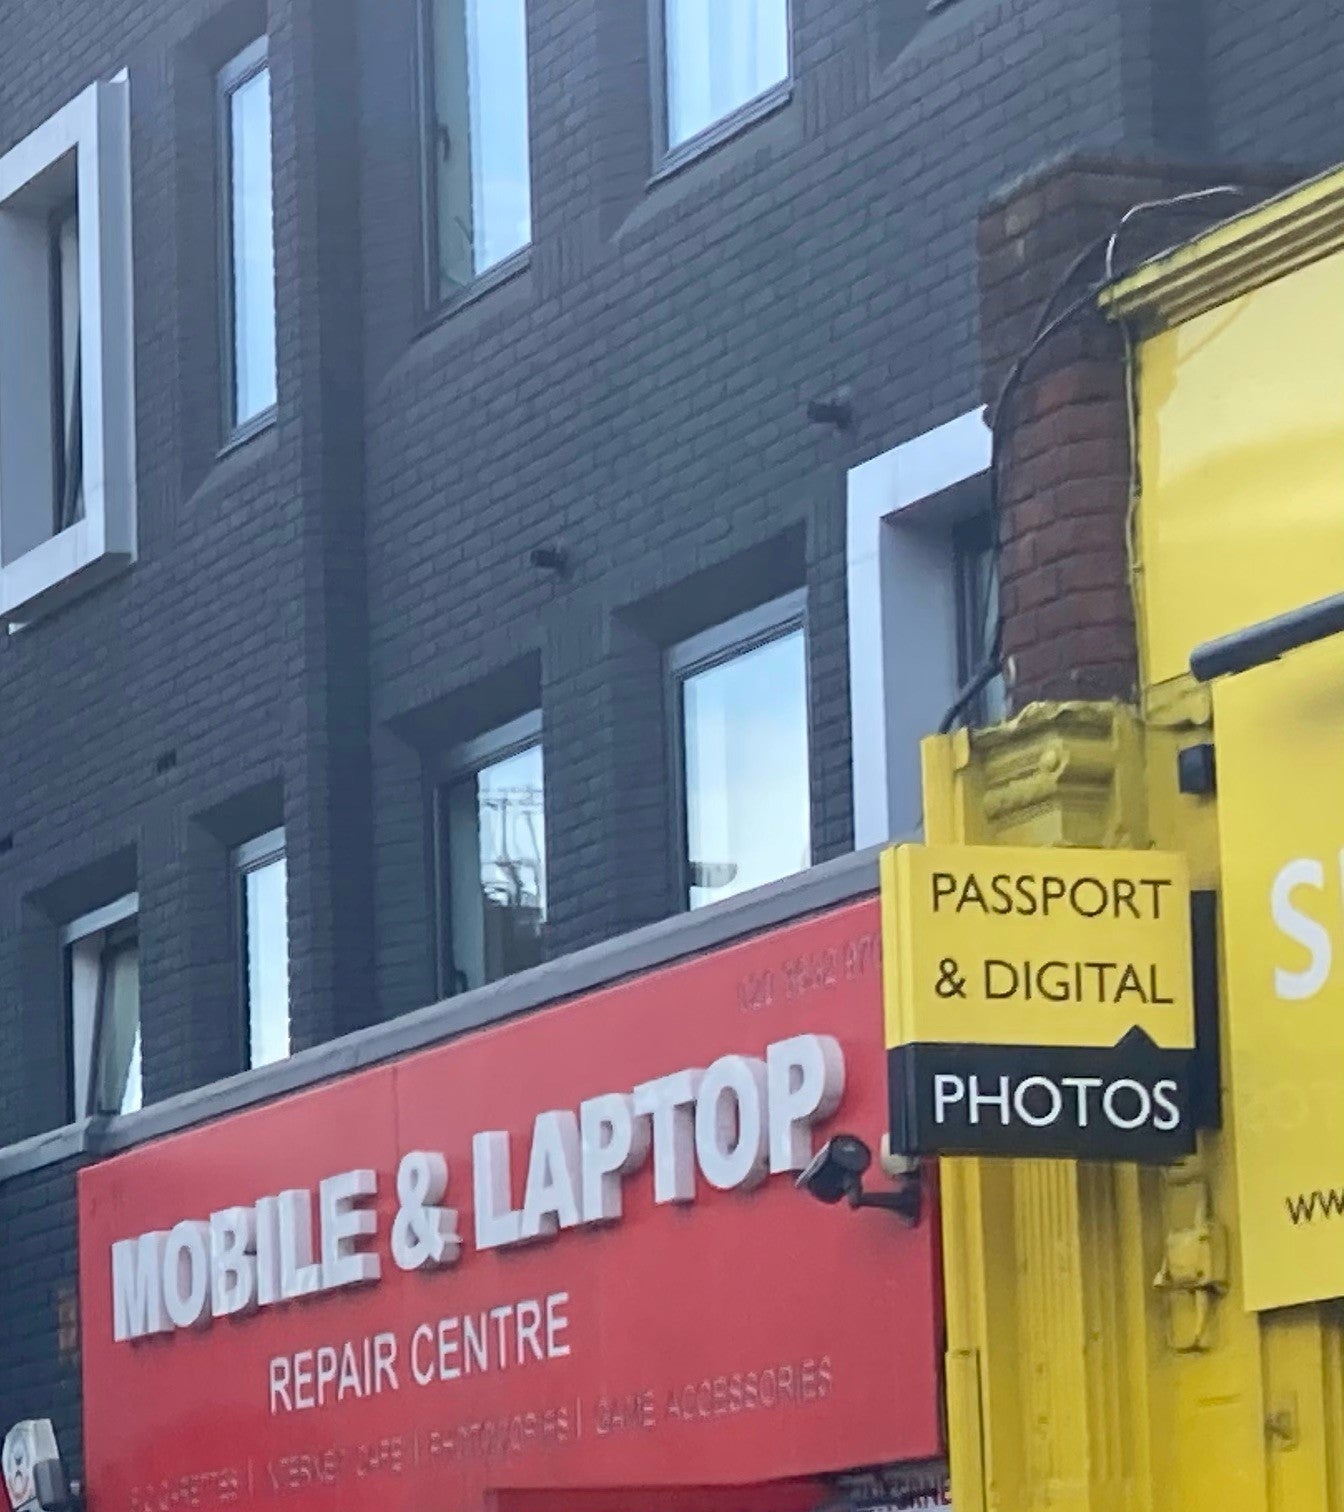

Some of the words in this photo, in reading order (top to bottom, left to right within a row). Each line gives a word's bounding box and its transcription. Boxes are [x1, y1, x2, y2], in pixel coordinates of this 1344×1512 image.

[932, 872, 1172, 919] PASSPORT
[934, 957, 967, 999] &
[984, 959, 1174, 1004] DIGITAL
[933, 1073, 1181, 1131] PHOTOS
[111, 1168, 381, 1343] MOBILE
[391, 1151, 462, 1273] &
[472, 1033, 846, 1249] LAPTOP
[269, 1331, 399, 1415] REPAIR
[410, 1292, 572, 1386] CENTRE
[667, 1354, 833, 1423] ACCESSORIES
